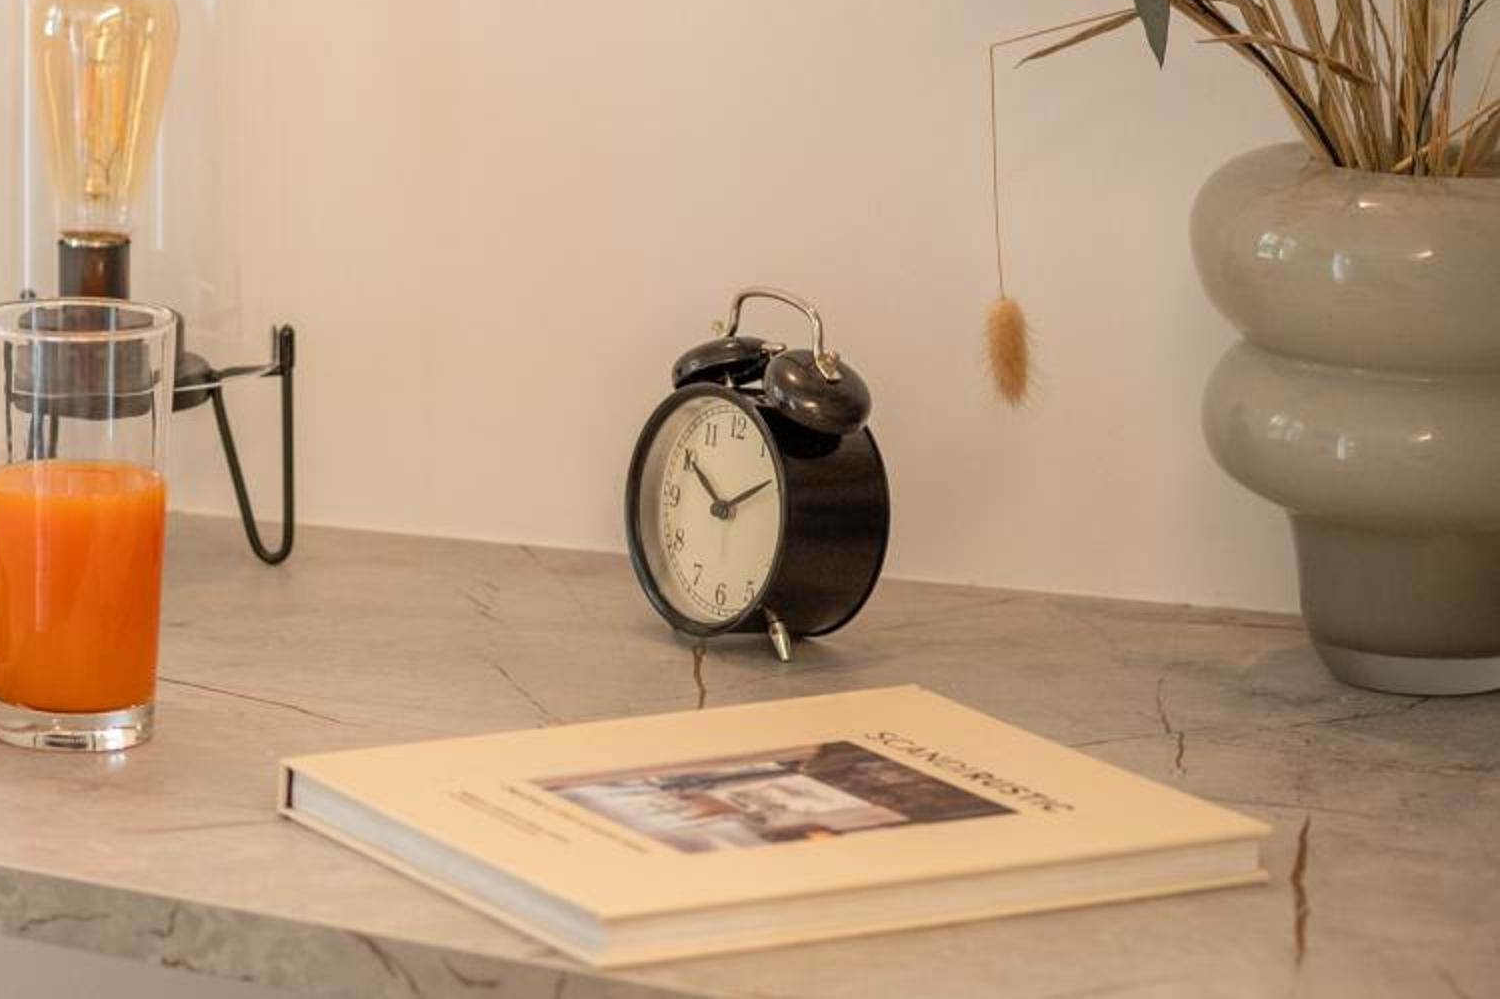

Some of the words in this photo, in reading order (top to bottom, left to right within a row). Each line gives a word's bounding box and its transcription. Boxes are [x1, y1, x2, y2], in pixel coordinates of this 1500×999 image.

[704, 422, 718, 448] 11
[730, 413, 747, 440] 12
[668, 485, 681, 508] 9
[674, 530, 685, 552] 8
[693, 563, 703, 586] 7
[715, 583, 726, 607] 6
[743, 580, 756, 602] 5
